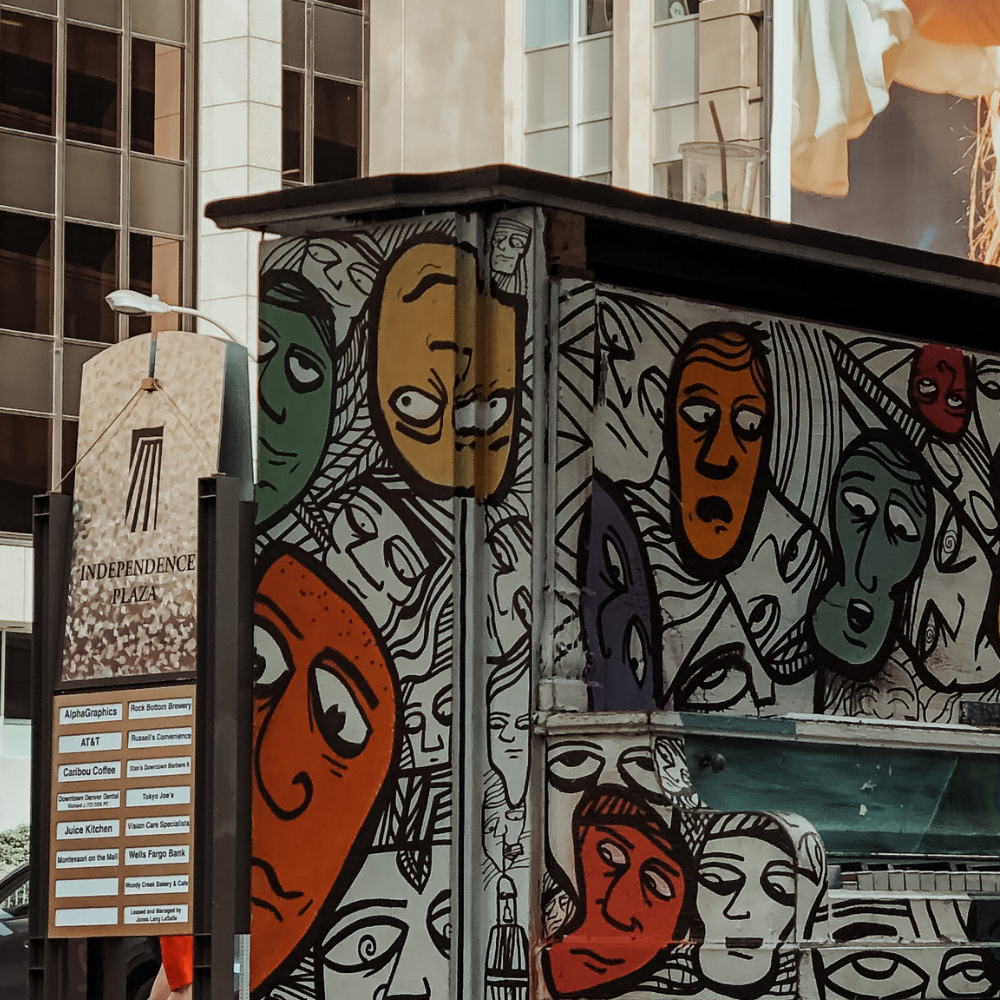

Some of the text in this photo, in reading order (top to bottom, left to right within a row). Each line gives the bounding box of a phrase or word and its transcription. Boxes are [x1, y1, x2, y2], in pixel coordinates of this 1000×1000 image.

[80, 554, 196, 581] INDEPENDENCE
[112, 586, 156, 604] PLAZA
[147, 703, 167, 711] Bottom
[169, 701, 191, 711] Brewery
[65, 708, 117, 719] AlphaGraphics
[157, 732, 191, 741] Convenience
[81, 737, 100, 747] AT&T
[63, 765, 115, 777] Caribou Coffee
[160, 820, 190, 828] Specialists
[64, 824, 113, 835] Juice Kitchen
[129, 849, 185, 859] Wells Fargo Bank
[156, 880, 172, 888] Bakery
